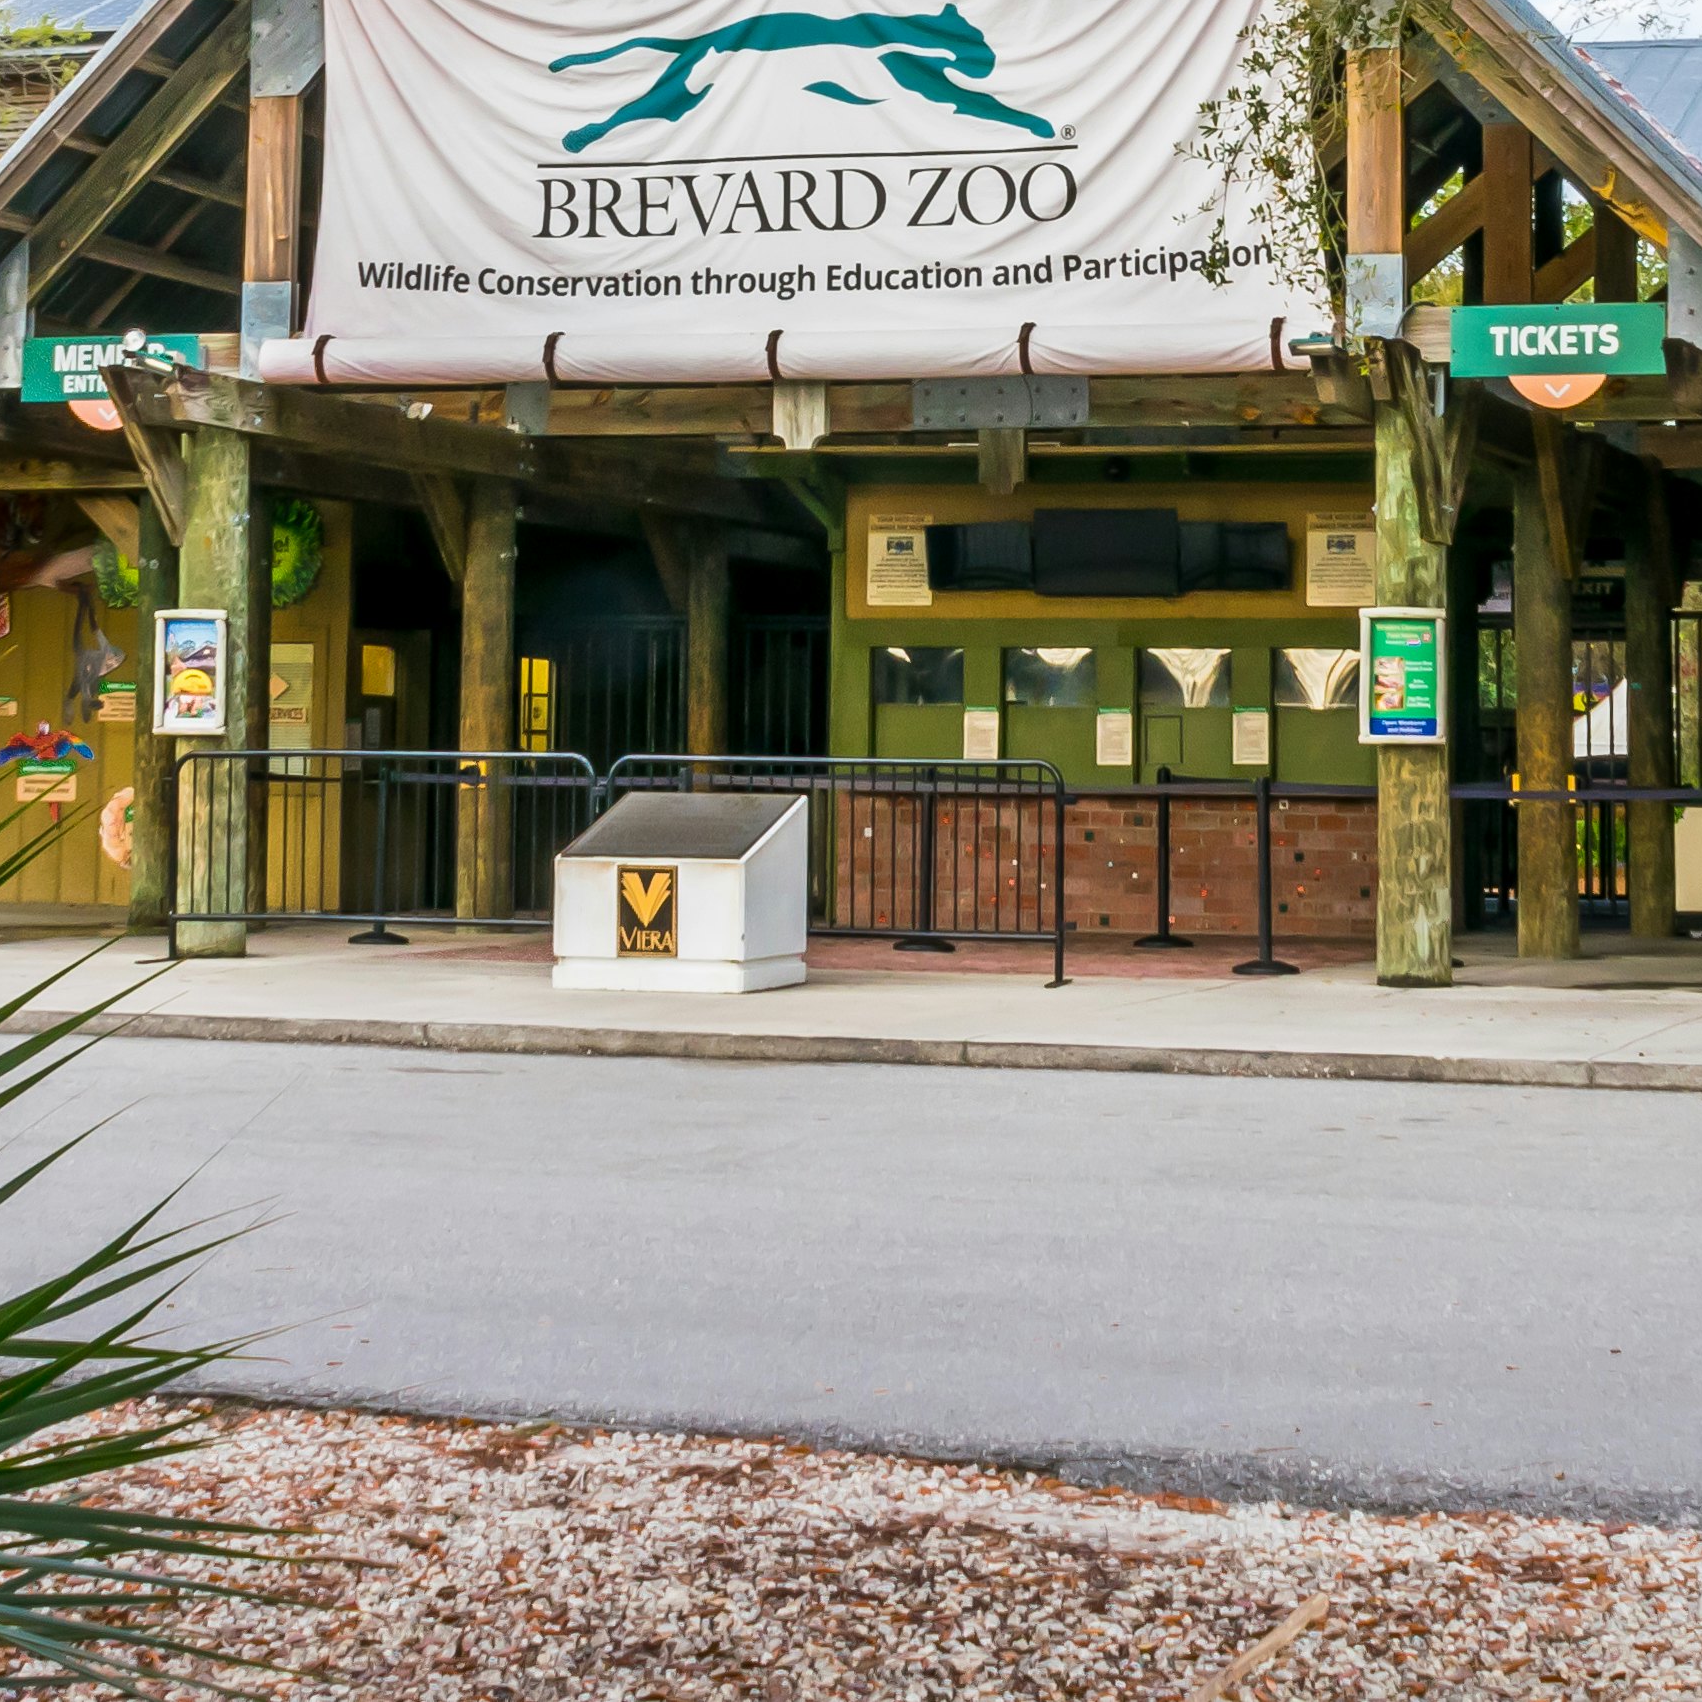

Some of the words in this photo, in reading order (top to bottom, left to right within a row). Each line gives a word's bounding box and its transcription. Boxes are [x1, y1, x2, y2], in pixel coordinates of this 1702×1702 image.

[532, 169, 887, 238] BREVARD
[907, 162, 1078, 227] ZOO
[358, 261, 470, 293] Wildlife
[478, 267, 682, 297] Conservation
[691, 265, 816, 301] through
[826, 261, 983, 292] Education
[992, 255, 1053, 286] and
[1489, 323, 1620, 357] TICKETS
[620, 926, 674, 951] VIERA
